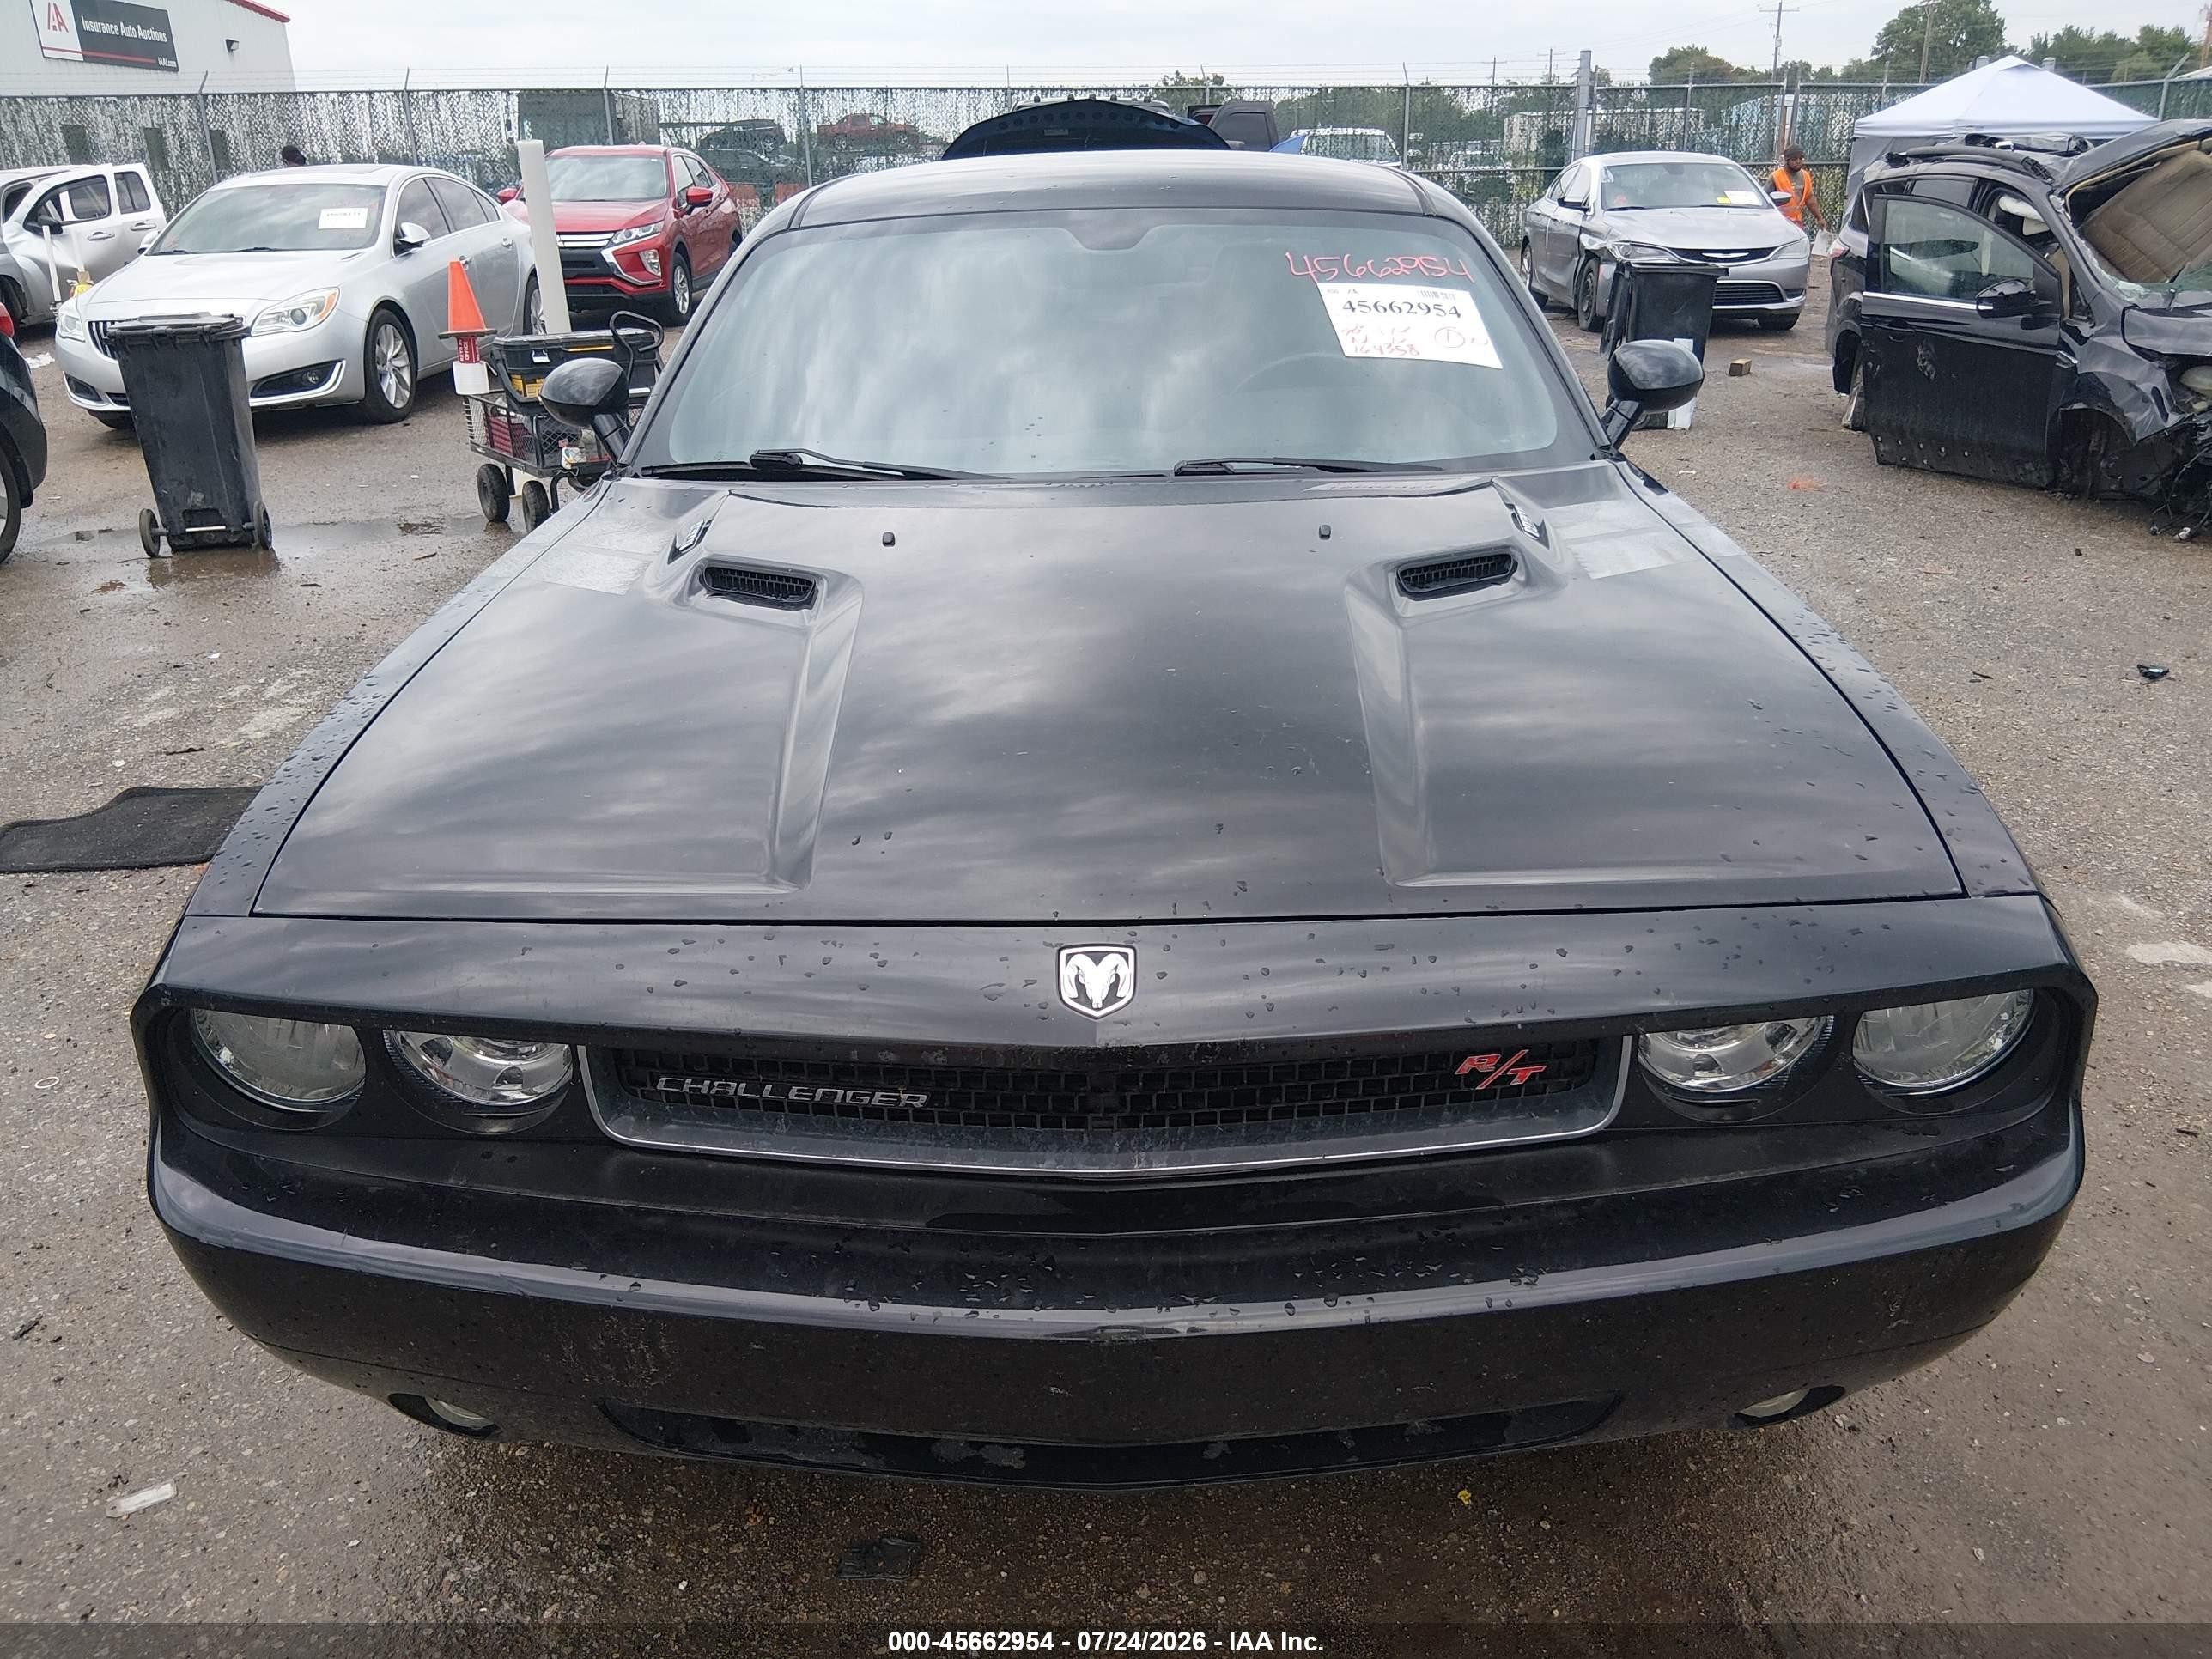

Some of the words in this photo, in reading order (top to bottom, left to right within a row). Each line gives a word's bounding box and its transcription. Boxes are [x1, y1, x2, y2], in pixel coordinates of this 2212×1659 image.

[82, 15, 119, 35] Insurance
[120, 21, 137, 39] Auto
[137, 24, 167, 42] Auctions
[1285, 252, 1475, 283] 45662954
[1342, 300, 1462, 319] 45662954
[1455, 1049, 1547, 1090] R/T
[656, 1077, 929, 1108] CHALLENGER
